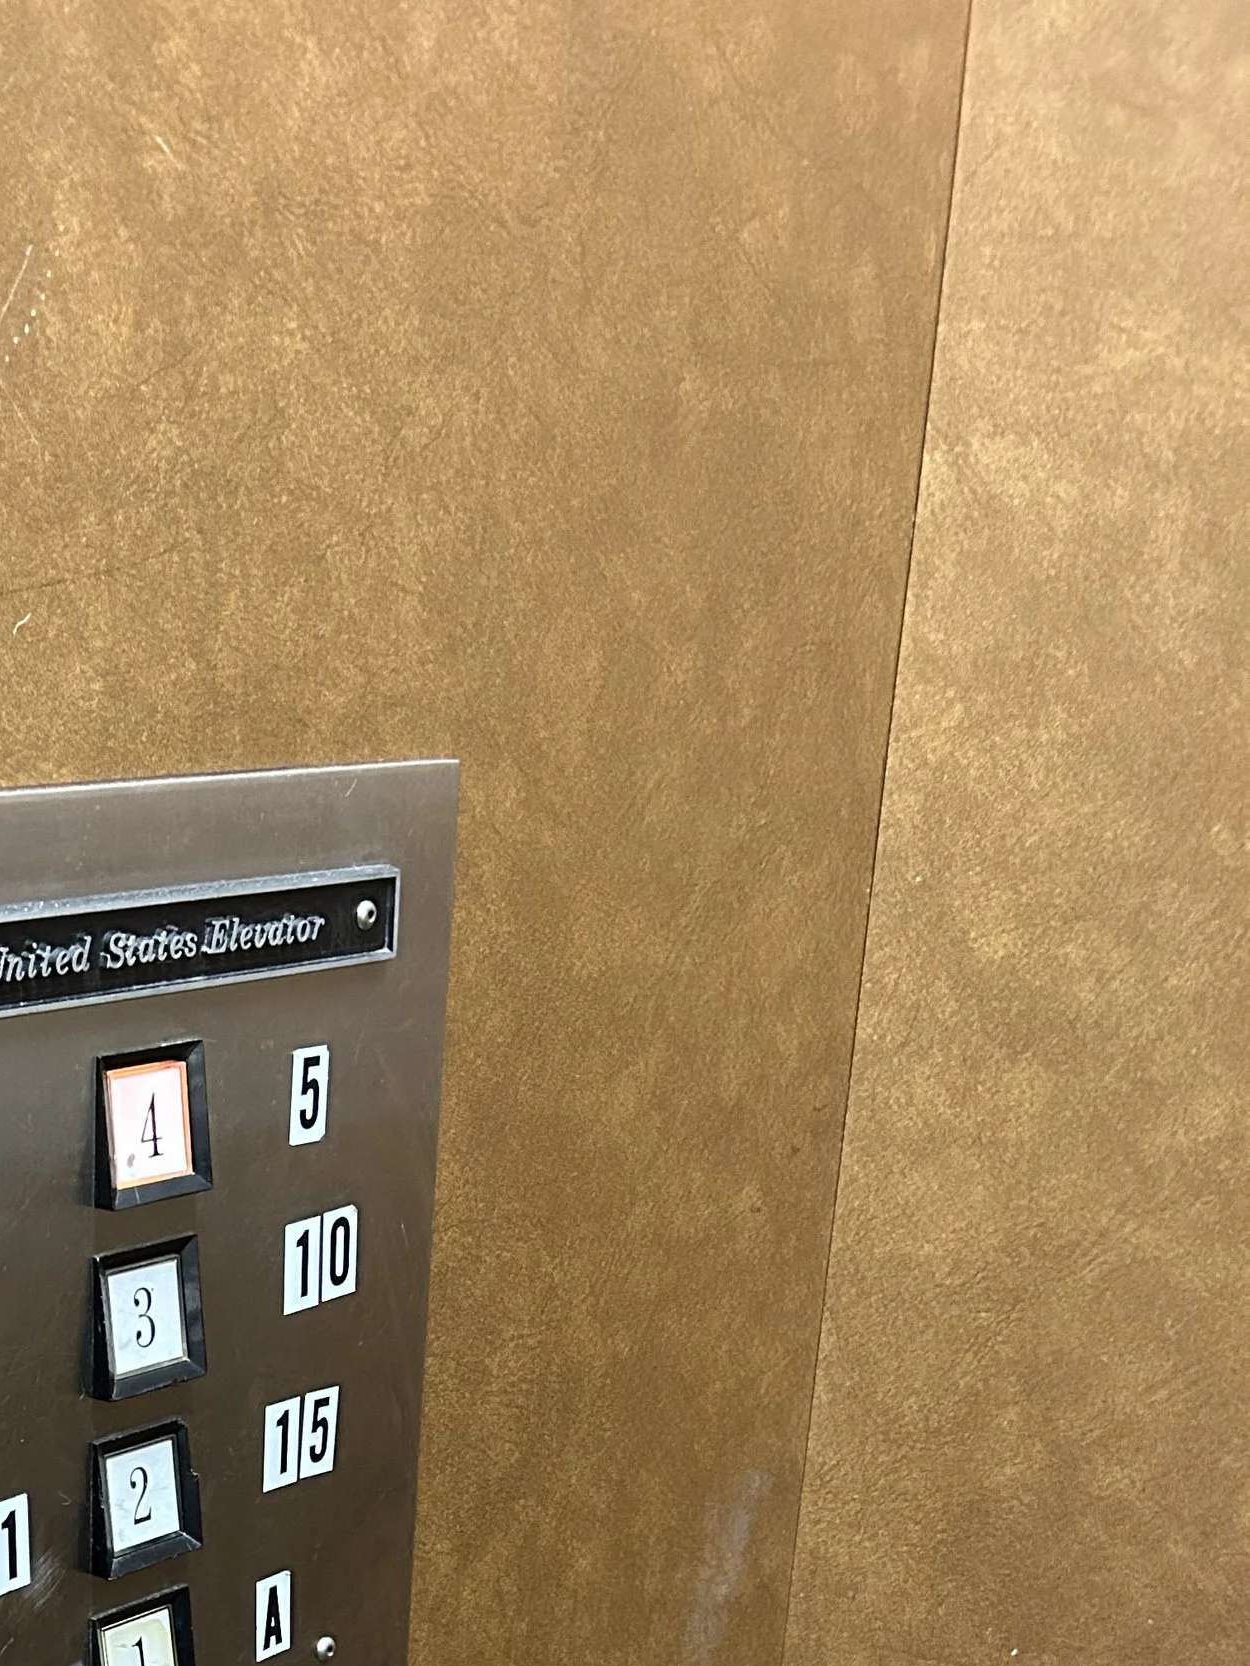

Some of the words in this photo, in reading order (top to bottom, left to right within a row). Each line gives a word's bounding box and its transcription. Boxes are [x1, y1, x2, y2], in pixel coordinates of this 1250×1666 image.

[101, 929, 198, 969] States
[202, 914, 326, 955] Elevator
[139, 1091, 165, 1159] 4
[299, 1055, 322, 1130] 5
[295, 1215, 351, 1299] 10
[133, 1286, 157, 1348] 3
[275, 1396, 331, 1476] 15
[128, 1465, 153, 1526] 2
[261, 1584, 284, 1652] A
